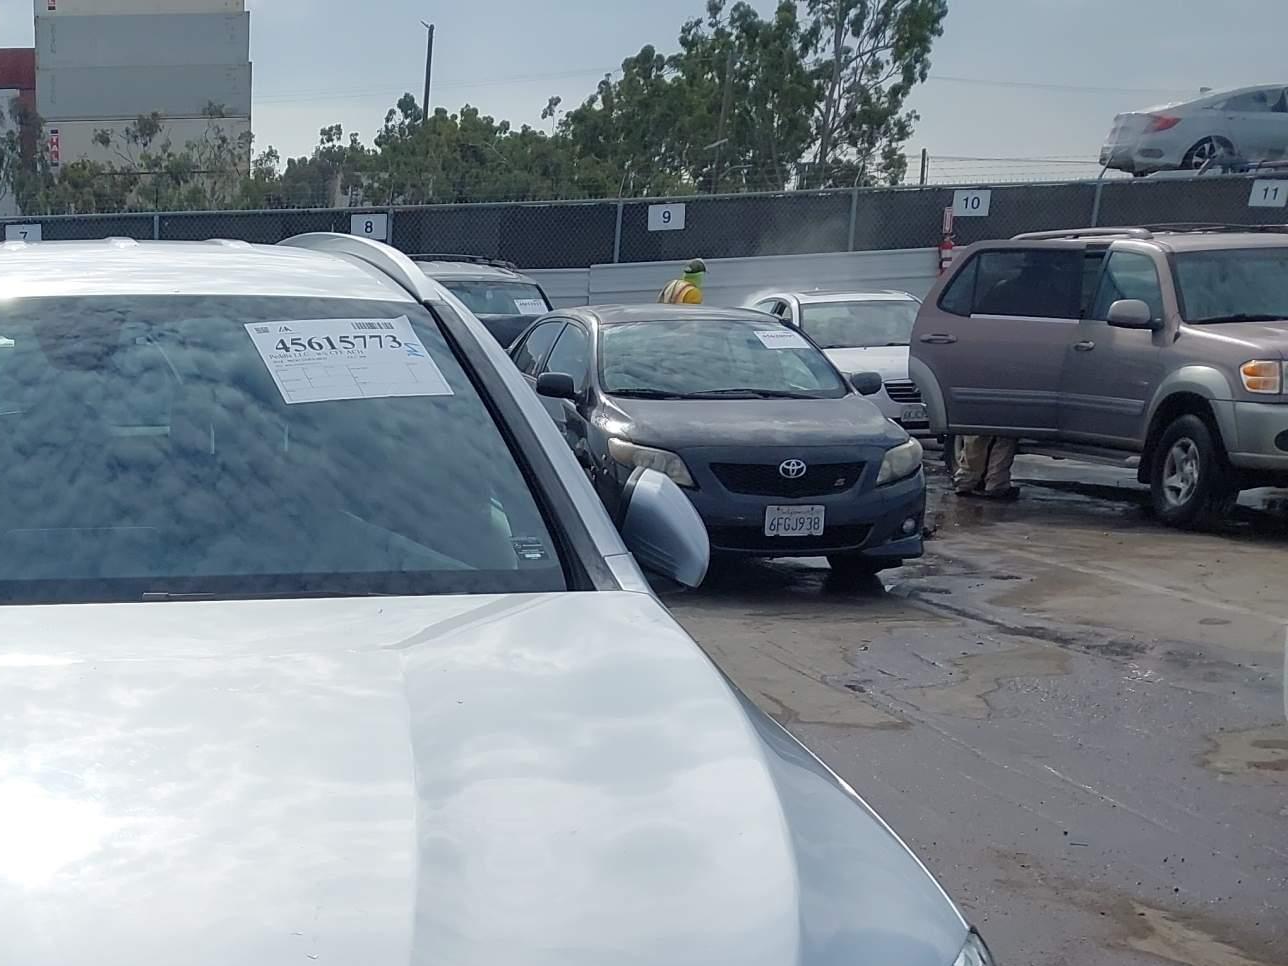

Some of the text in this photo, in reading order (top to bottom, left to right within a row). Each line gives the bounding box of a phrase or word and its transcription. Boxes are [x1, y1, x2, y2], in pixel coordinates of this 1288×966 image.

[1264, 186, 1279, 201] 11
[963, 196, 981, 210] 10
[662, 210, 672, 224] 9
[364, 220, 374, 234] 8
[19, 231, 29, 240] 7
[275, 334, 403, 353] 45615773
[768, 516, 821, 532] 6FGJ938
